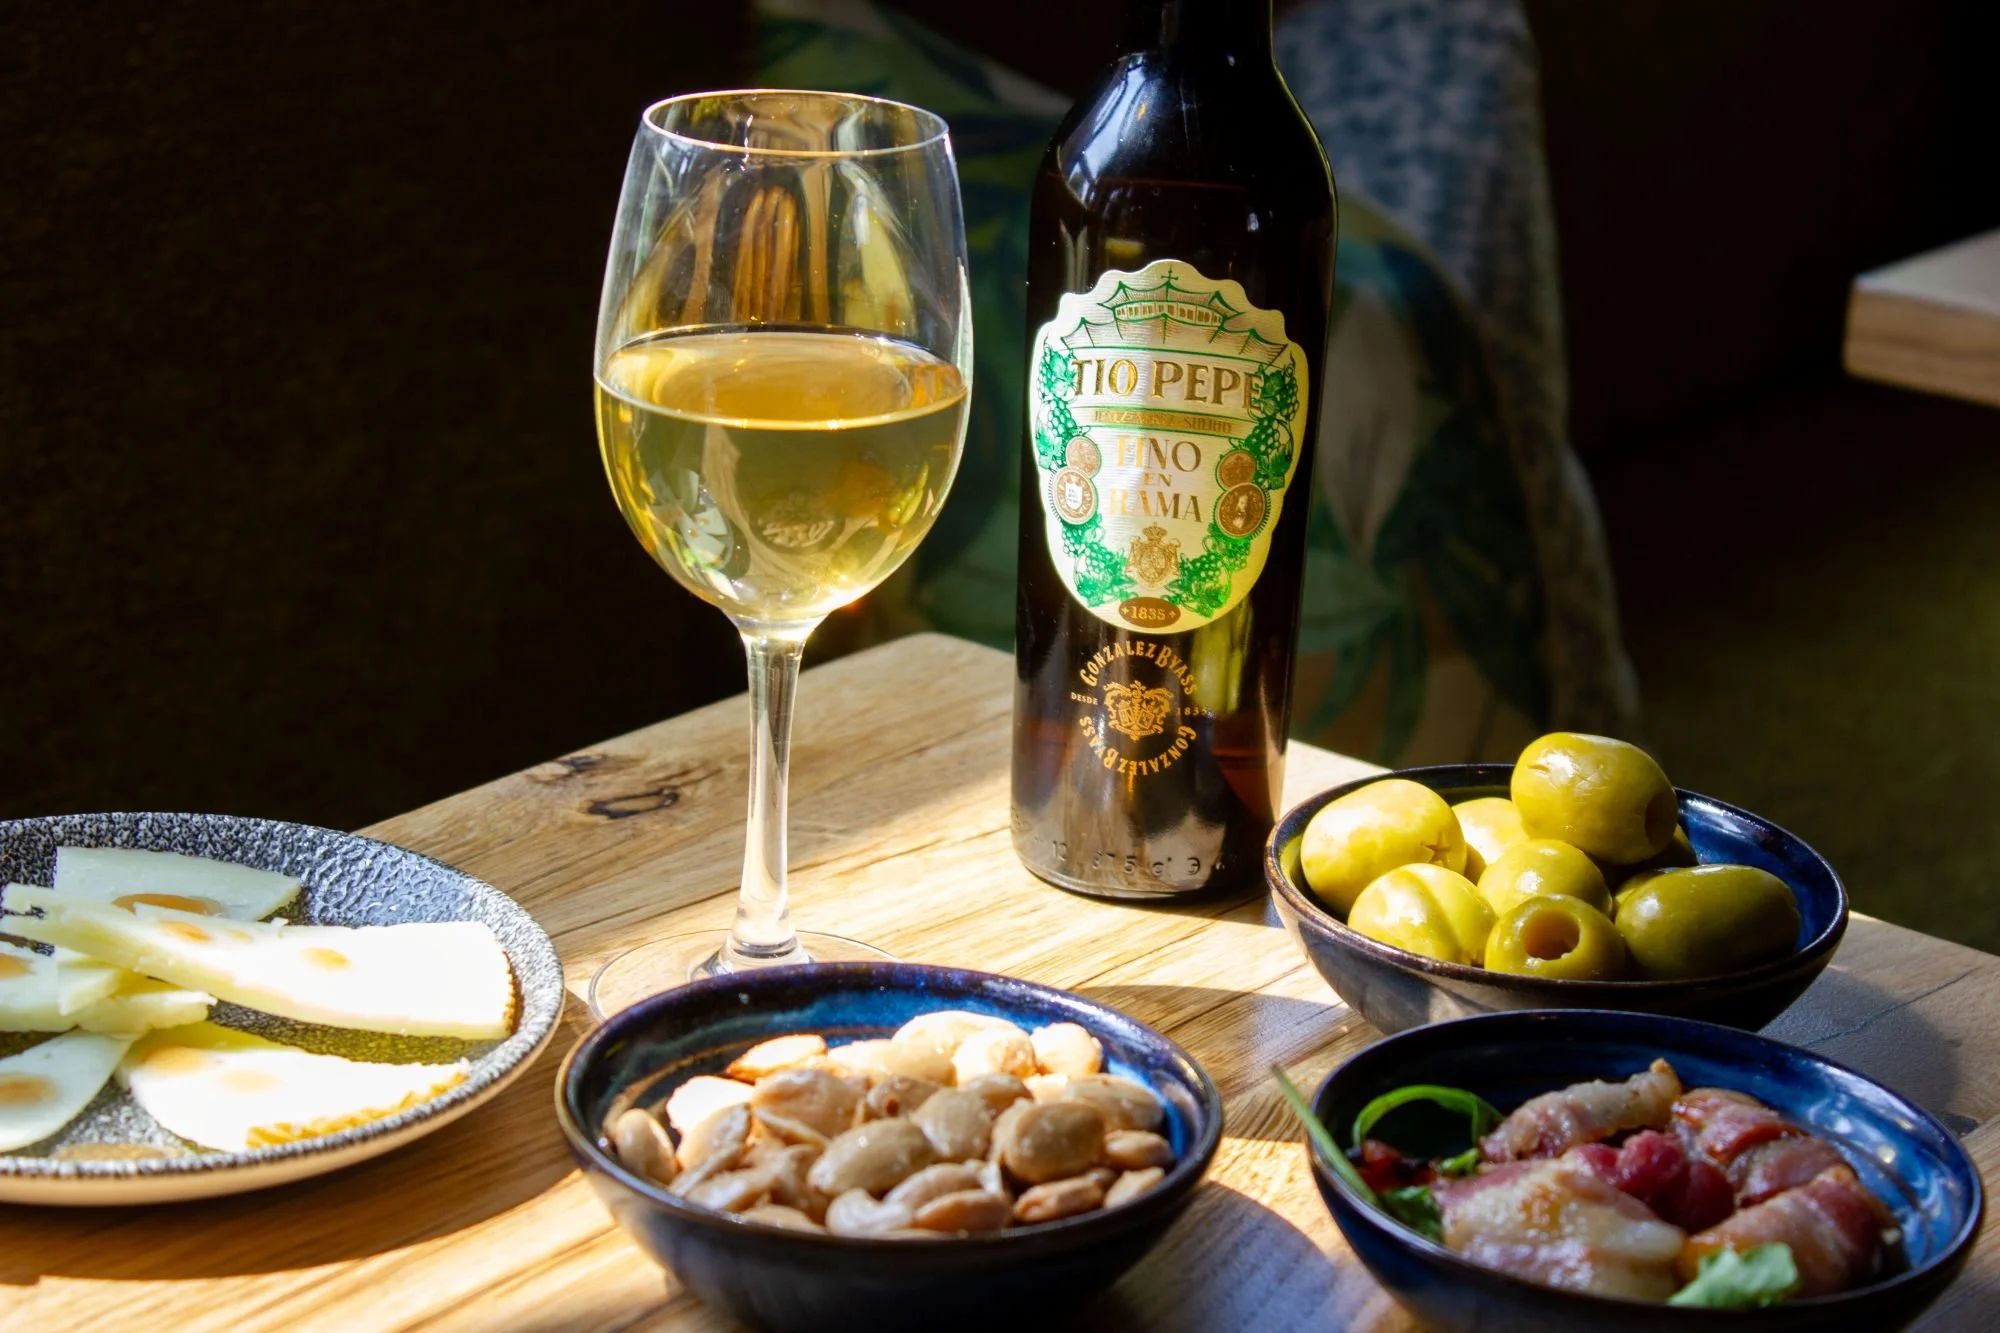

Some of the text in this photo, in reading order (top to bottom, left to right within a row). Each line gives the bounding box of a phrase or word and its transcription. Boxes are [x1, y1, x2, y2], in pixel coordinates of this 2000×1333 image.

[1072, 359, 1262, 411] TIO PEPE
[1143, 472, 1173, 488] EN
[1109, 488, 1203, 523] RAMA
[1131, 606, 1166, 621] 1835
[1080, 640, 1158, 687] GONZALEZ
[1070, 691, 1099, 706] DESDE
[1116, 725, 1197, 776] GONZALEZ
